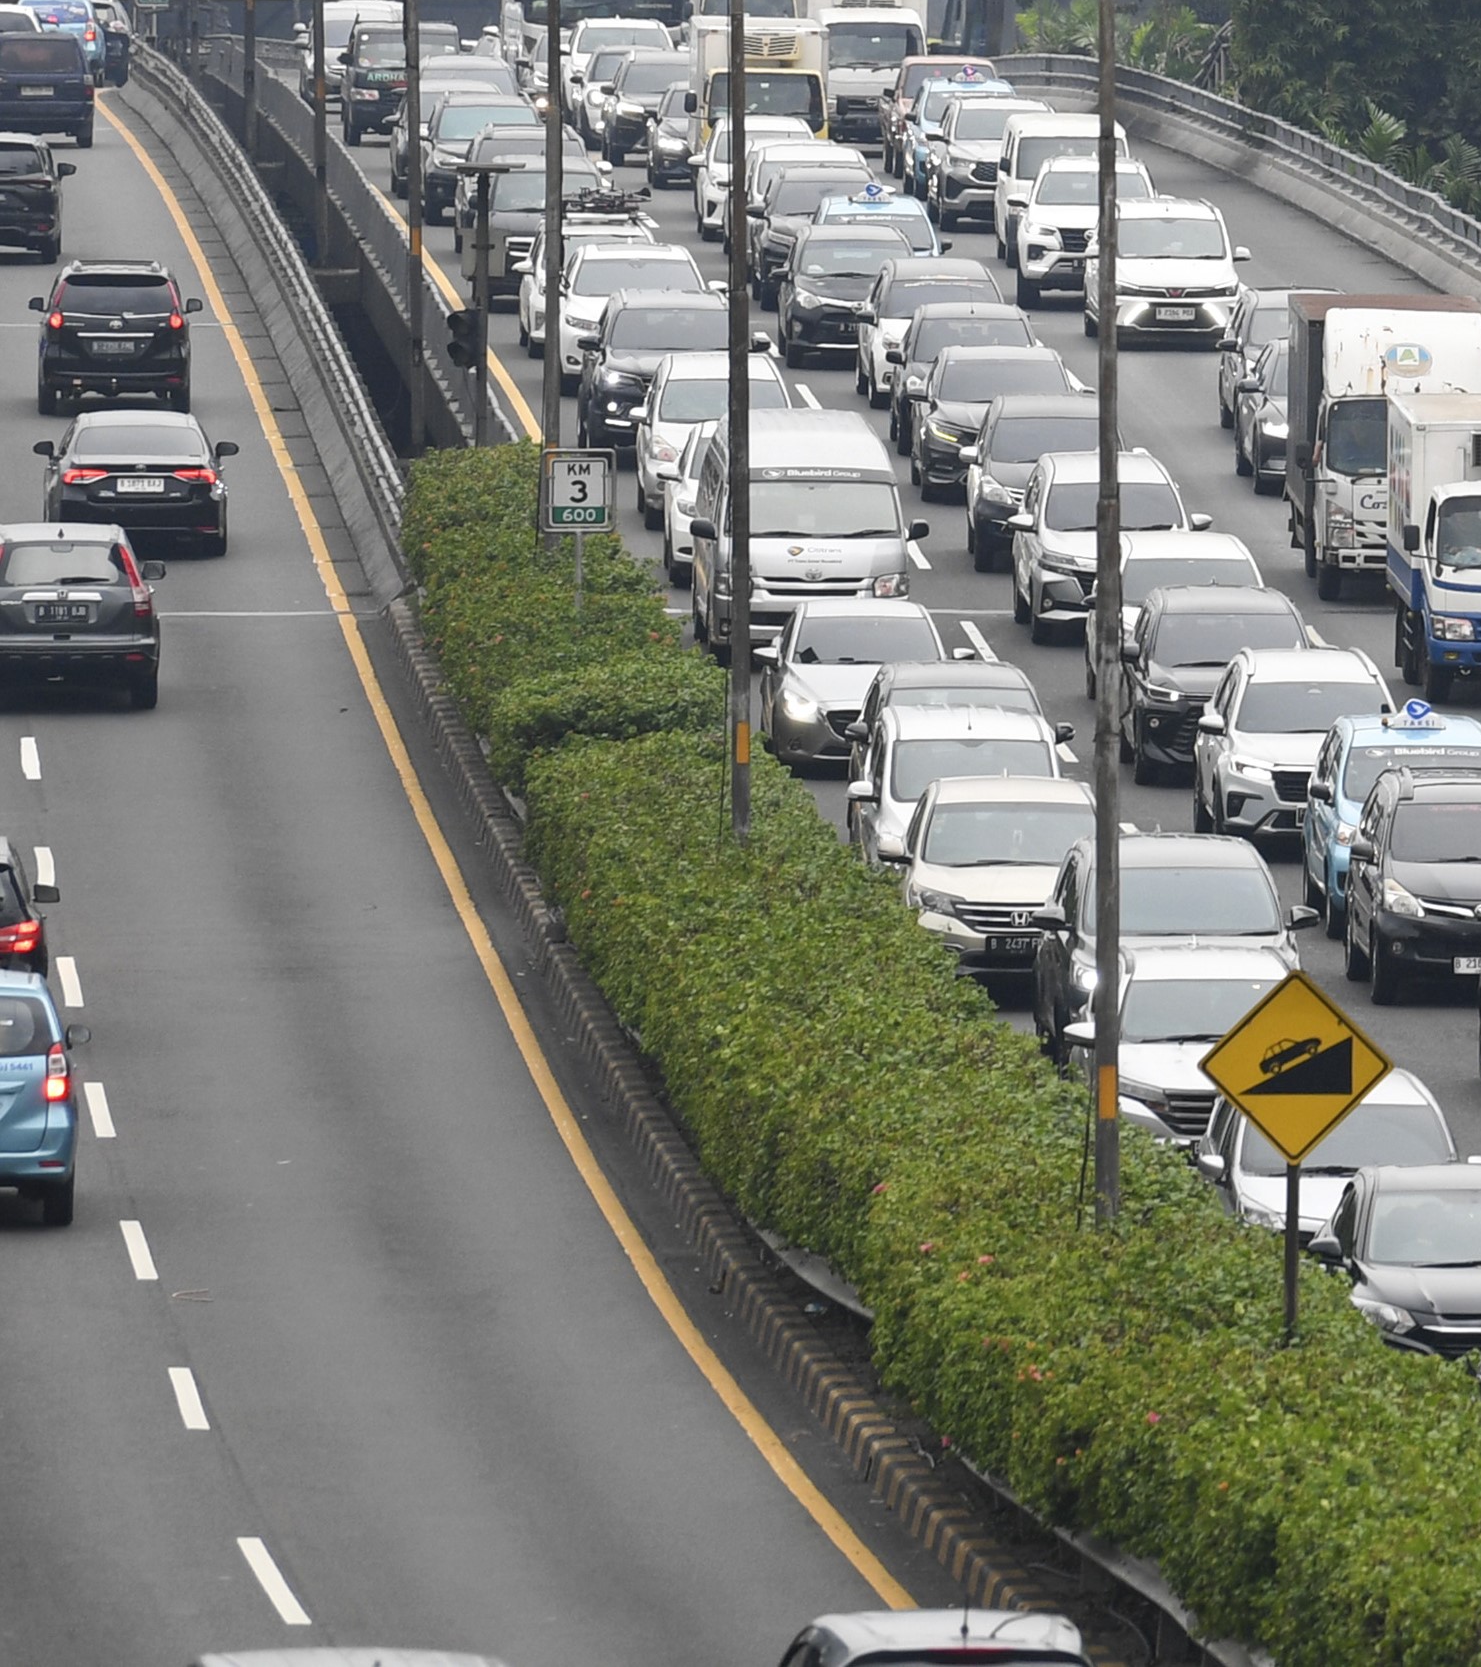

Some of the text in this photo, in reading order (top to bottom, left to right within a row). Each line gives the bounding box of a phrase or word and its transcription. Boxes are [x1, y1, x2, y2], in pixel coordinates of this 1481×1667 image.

[567, 463, 591, 476] KM
[787, 468, 861, 479] Bluebird Group
[569, 480, 588, 503] 3
[562, 508, 596, 522] 600
[1394, 747, 1480, 757] Bluebird Group
[991, 937, 997, 949] B
[1006, 937, 1030, 949] 2437
[1455, 958, 1461, 969] B
